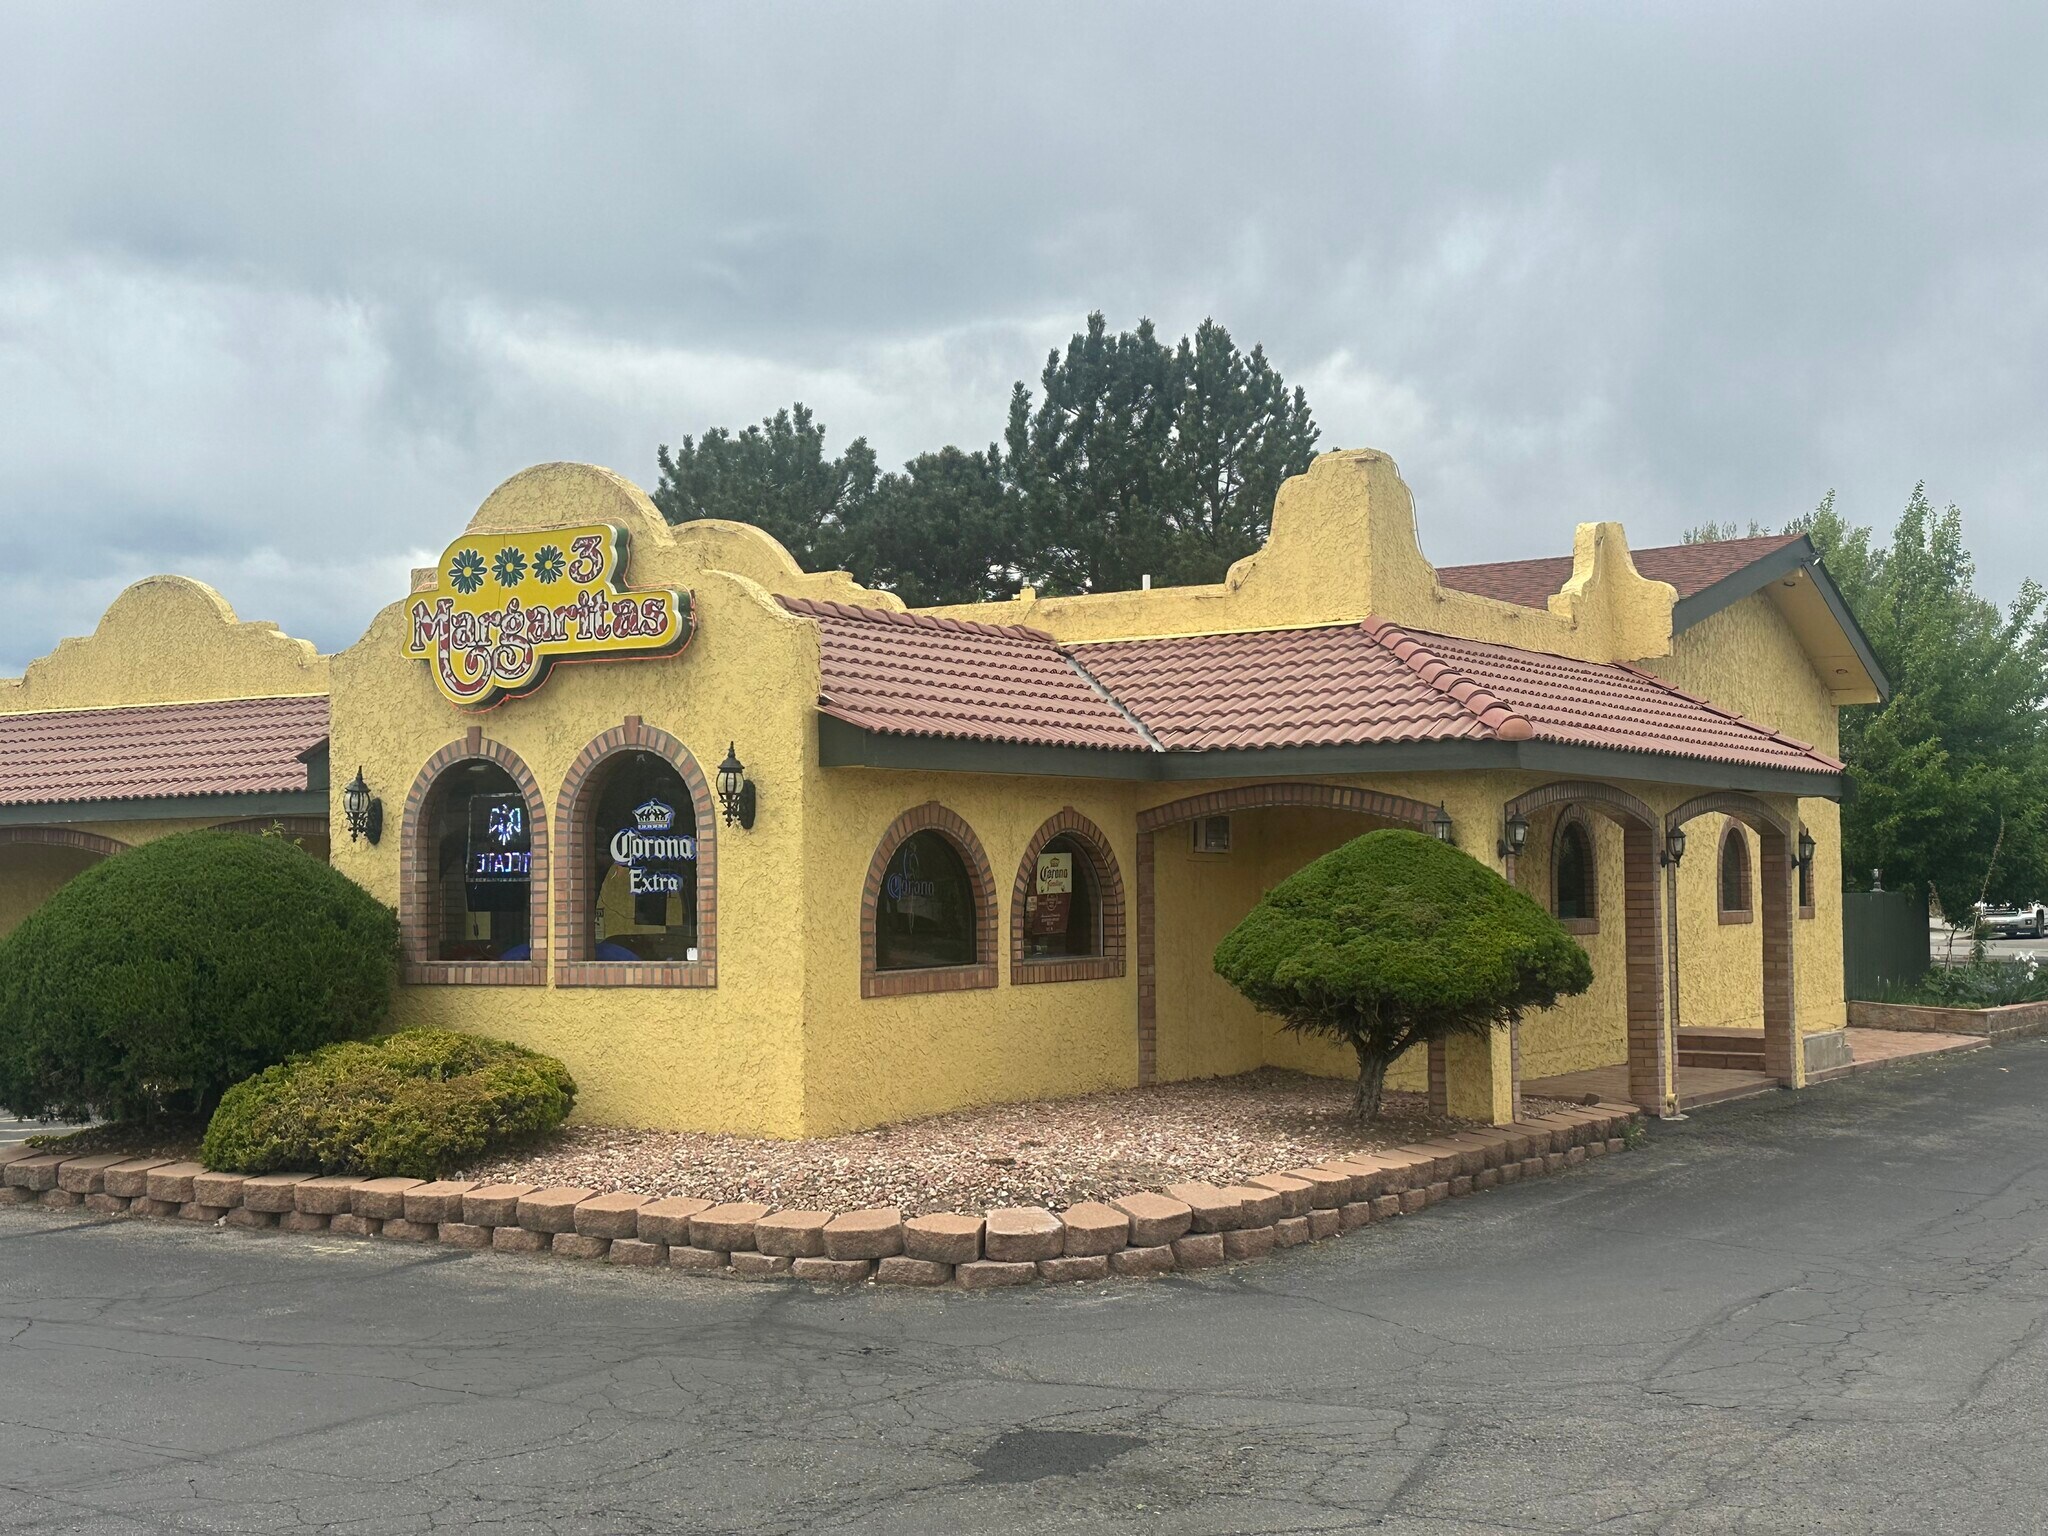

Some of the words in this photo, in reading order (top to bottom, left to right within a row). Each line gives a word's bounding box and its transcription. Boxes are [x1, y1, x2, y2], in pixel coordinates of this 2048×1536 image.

[568, 535, 605, 584] 3
[410, 590, 669, 696] Margaritas
[610, 828, 695, 866] Corona
[629, 868, 679, 894] Extra
[887, 872, 935, 902] Corona
[1040, 865, 1068, 883] Corona
